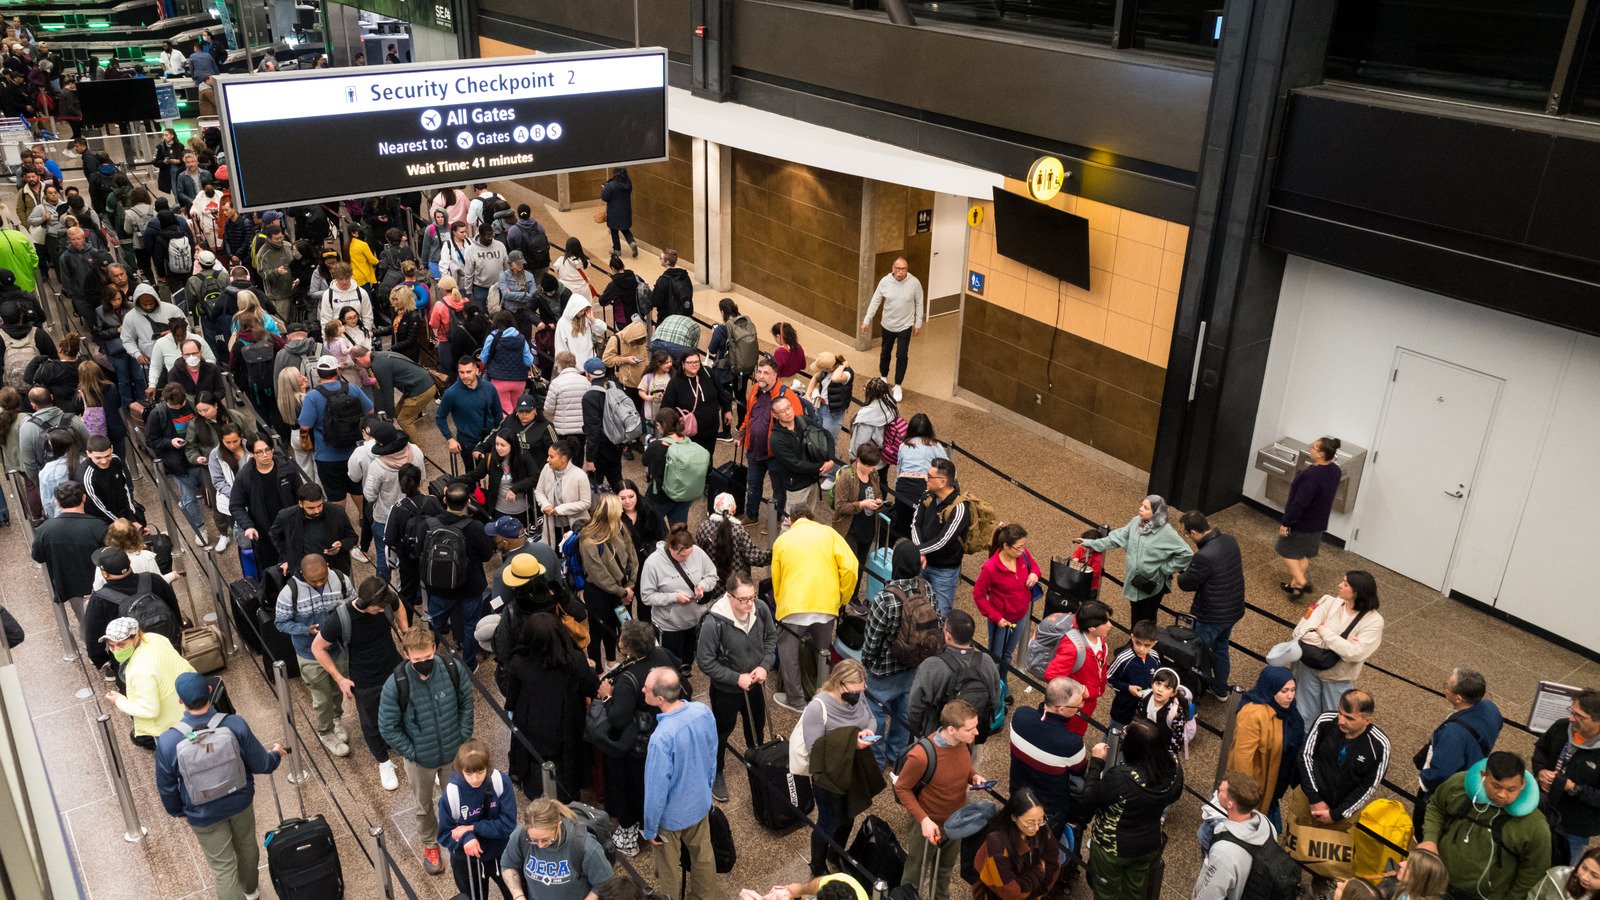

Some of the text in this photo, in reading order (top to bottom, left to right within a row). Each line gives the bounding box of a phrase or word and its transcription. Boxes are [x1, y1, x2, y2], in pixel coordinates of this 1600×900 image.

[370, 70, 576, 101] Security Checkpoint 2
[446, 106, 516, 126] All Gates
[378, 138, 428, 156] Nearest
[430, 137, 448, 150] to:
[476, 130, 511, 145] Gates
[516, 128, 526, 140] A
[534, 127, 542, 139] B
[405, 152, 534, 176] Wait Time: 41 minutes
[477, 250, 501, 260] HOU
[1308, 839, 1352, 863] NIKE
[525, 854, 571, 879] DECA
